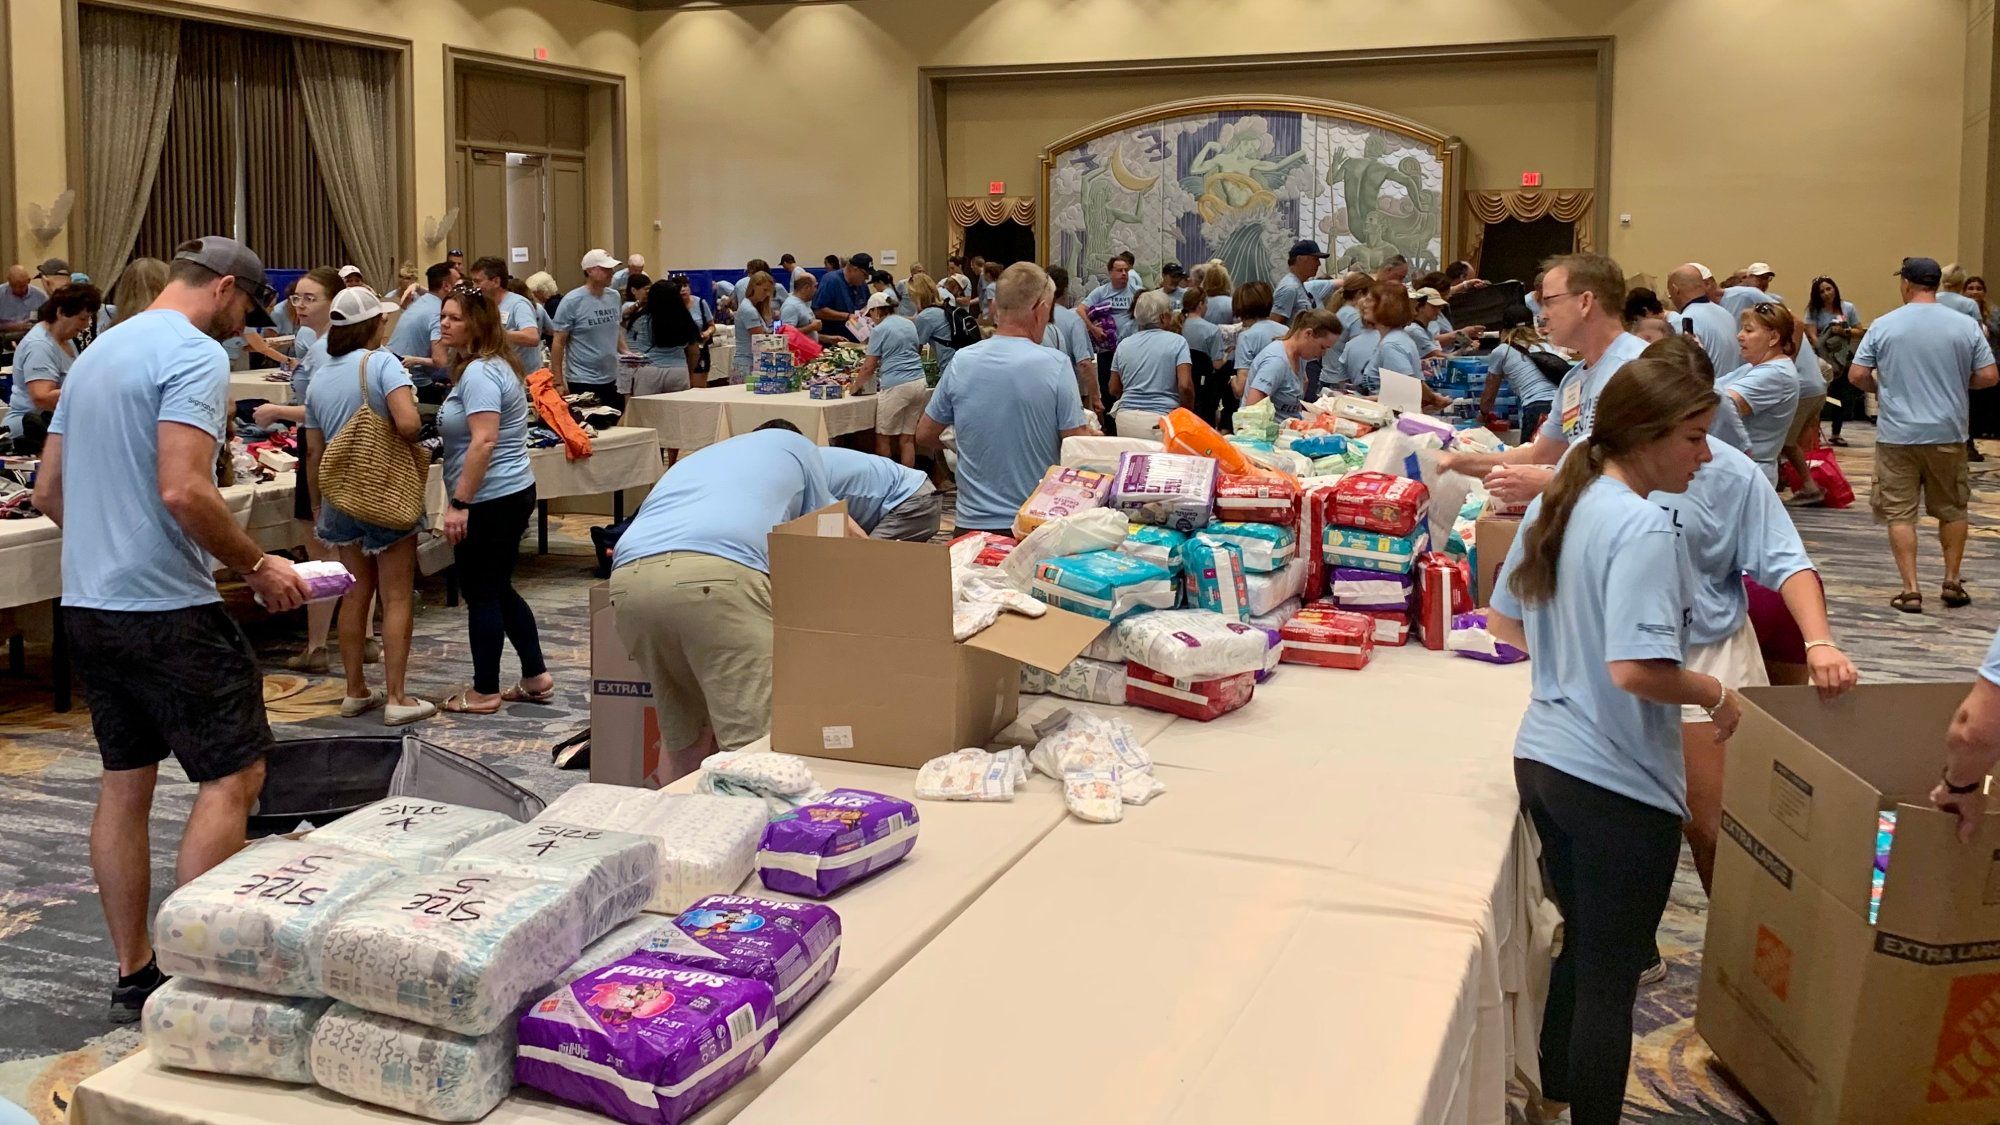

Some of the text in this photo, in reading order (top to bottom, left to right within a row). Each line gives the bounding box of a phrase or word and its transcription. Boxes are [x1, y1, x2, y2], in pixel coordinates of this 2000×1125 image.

[598, 682, 639, 695] EXTRA
[379, 804, 448, 815] SIZE
[386, 817, 419, 831] 4
[538, 826, 604, 840] SIZE
[528, 840, 559, 857] 4
[279, 855, 332, 875] 5
[234, 875, 328, 906] SIZE
[439, 878, 489, 895] 5
[402, 894, 486, 921] SIZE
[739, 936, 772, 948] 3T-4T
[1883, 938, 1953, 962] EXTRA
[652, 1017, 685, 1029] 2T-3T
